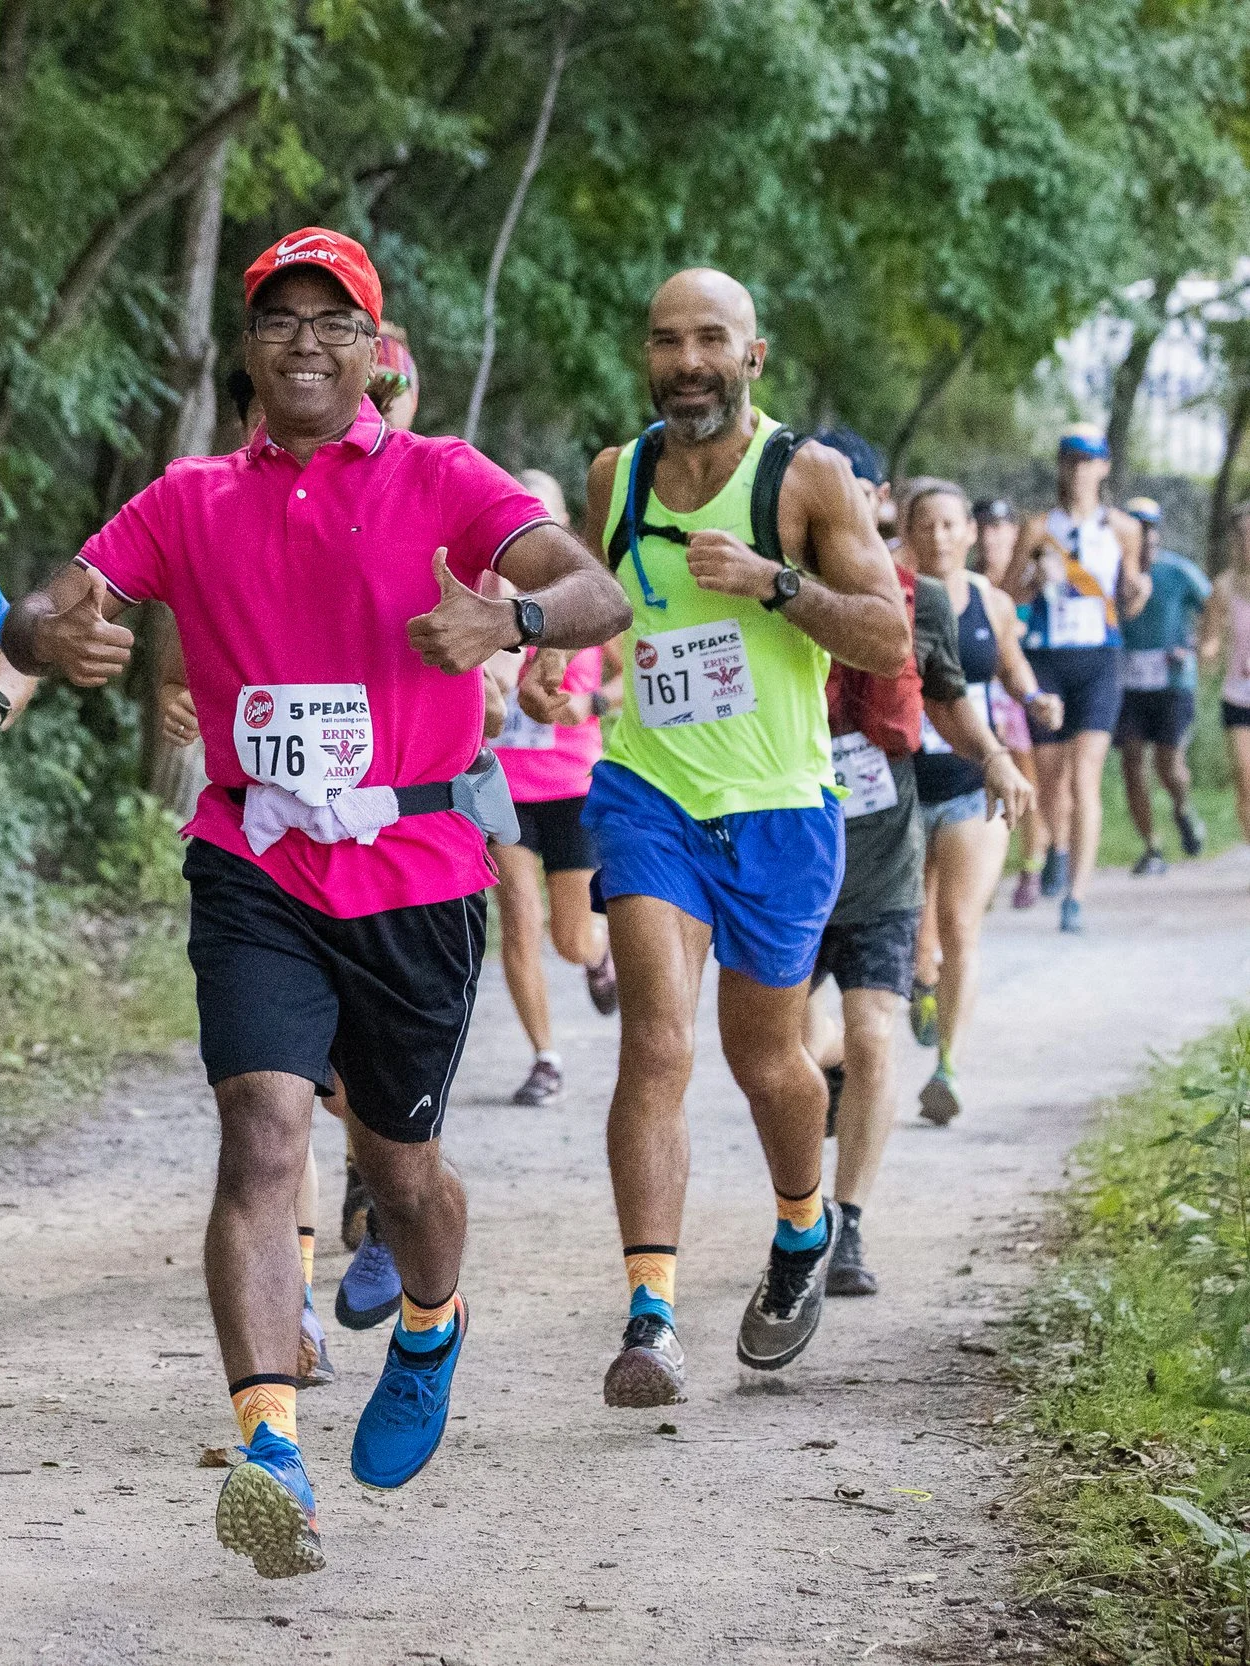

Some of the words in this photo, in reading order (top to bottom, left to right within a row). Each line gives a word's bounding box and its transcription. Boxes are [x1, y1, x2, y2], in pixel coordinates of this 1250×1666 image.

[275, 249, 338, 267] HOCKEY
[672, 645, 685, 658] 5
[687, 632, 740, 653] PEAKS
[640, 670, 690, 705] 767
[713, 682, 744, 698] ARMY
[289, 703, 304, 720] 5
[309, 702, 368, 716] PEAKS
[322, 729, 366, 740] ERIN'S
[247, 734, 306, 777] 776
